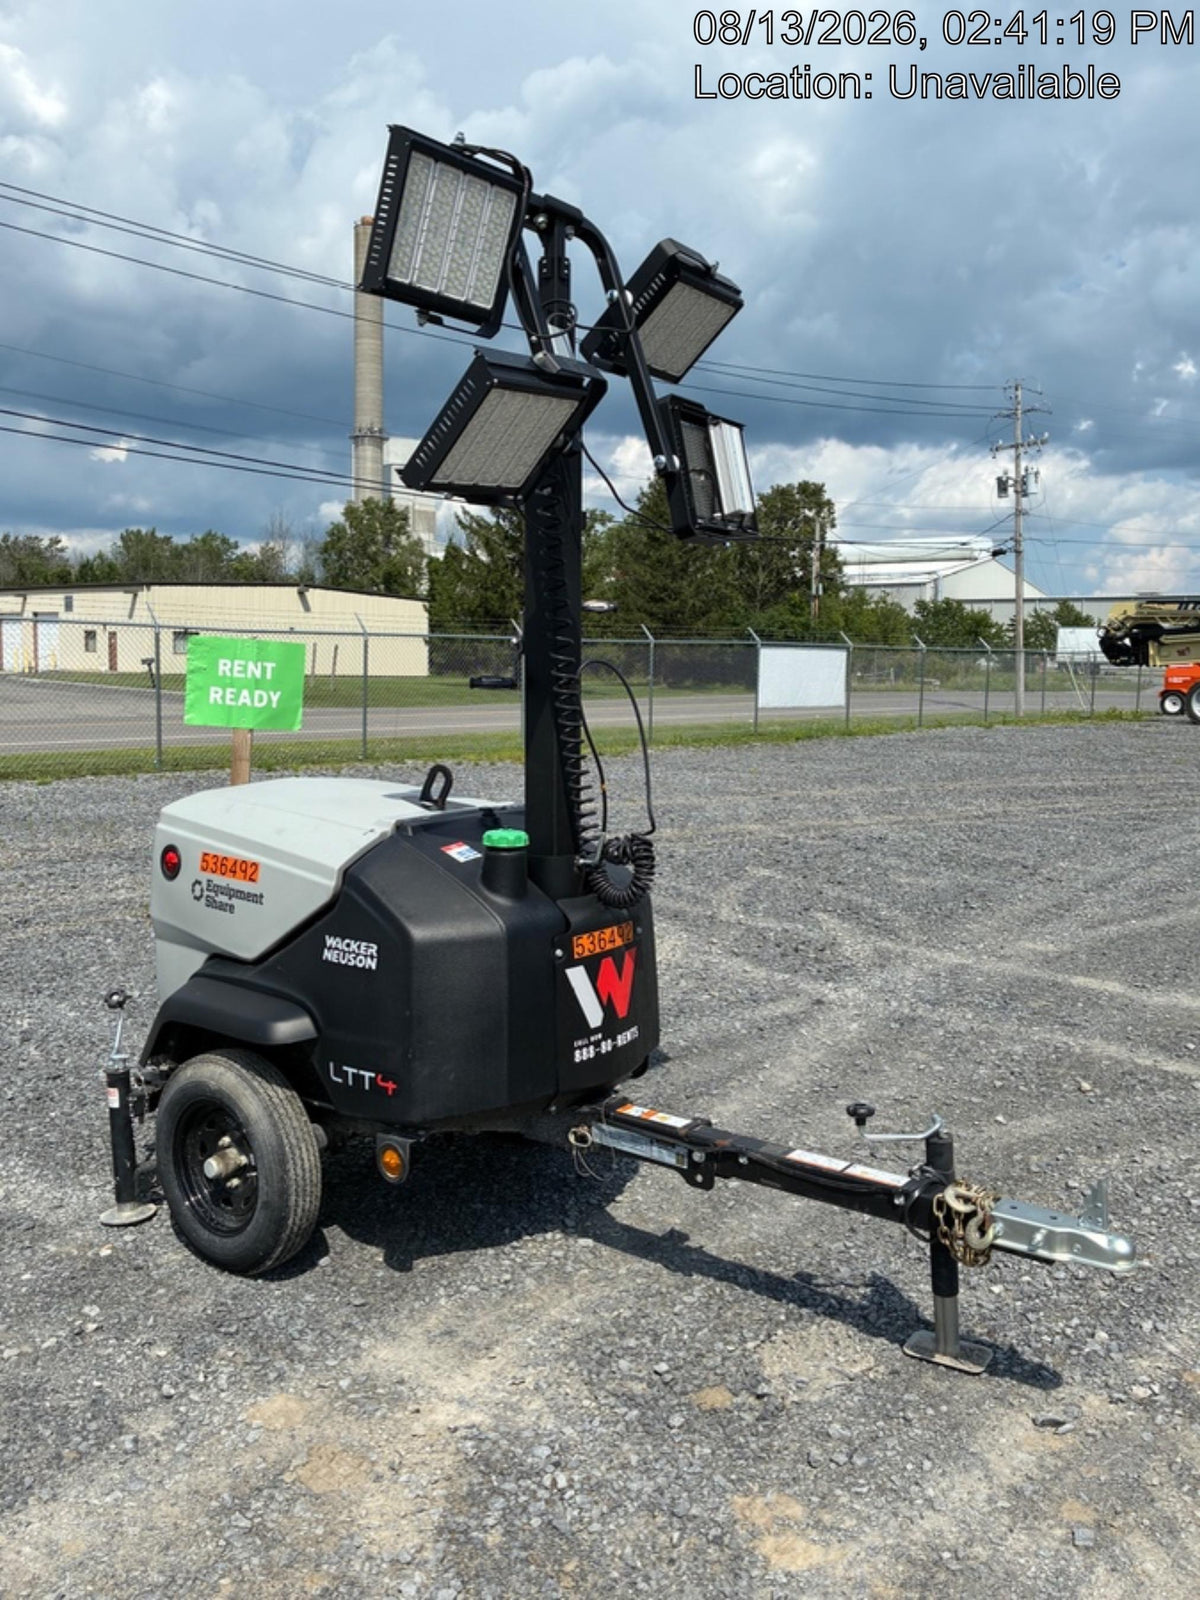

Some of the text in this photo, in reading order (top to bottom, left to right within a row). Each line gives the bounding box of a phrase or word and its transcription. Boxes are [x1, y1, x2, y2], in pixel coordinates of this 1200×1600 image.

[218, 658, 276, 680] RENT
[209, 686, 281, 708] READY
[201, 852, 259, 882] 536492
[205, 879, 264, 905] Equipment
[205, 894, 235, 914] Share
[324, 934, 378, 957] WACKER
[574, 922, 634, 957] 536492
[322, 947, 378, 970] NEUSON
[329, 1061, 397, 1095] LTT4
